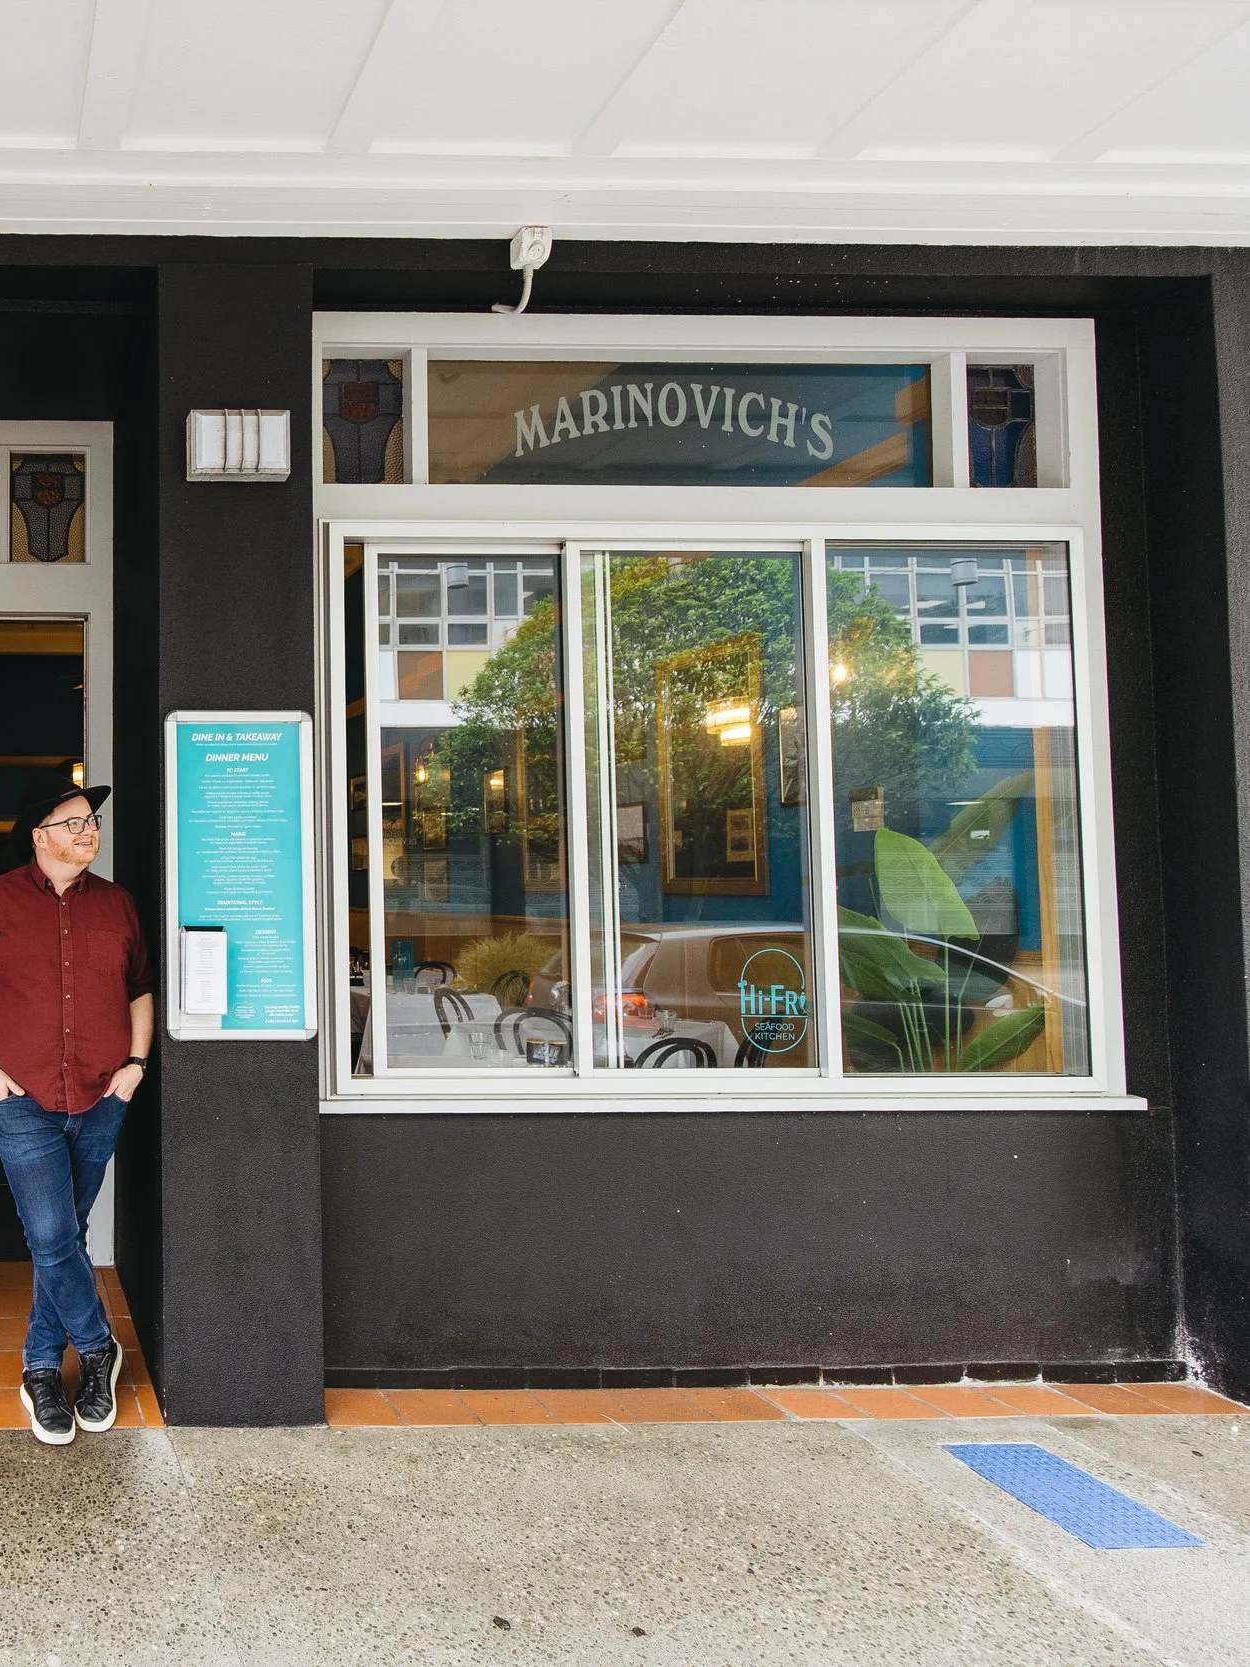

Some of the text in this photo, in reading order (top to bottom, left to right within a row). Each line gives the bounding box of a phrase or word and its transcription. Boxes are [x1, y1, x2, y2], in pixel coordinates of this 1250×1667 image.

[513, 382, 835, 461] MARINOVICH'S
[191, 732, 282, 742] DINE IN & TAKEAWAY
[205, 753, 269, 762] DINNER MENU
[754, 1022, 795, 1031] SEAFOOD
[754, 1032, 796, 1041] KITCHEN
